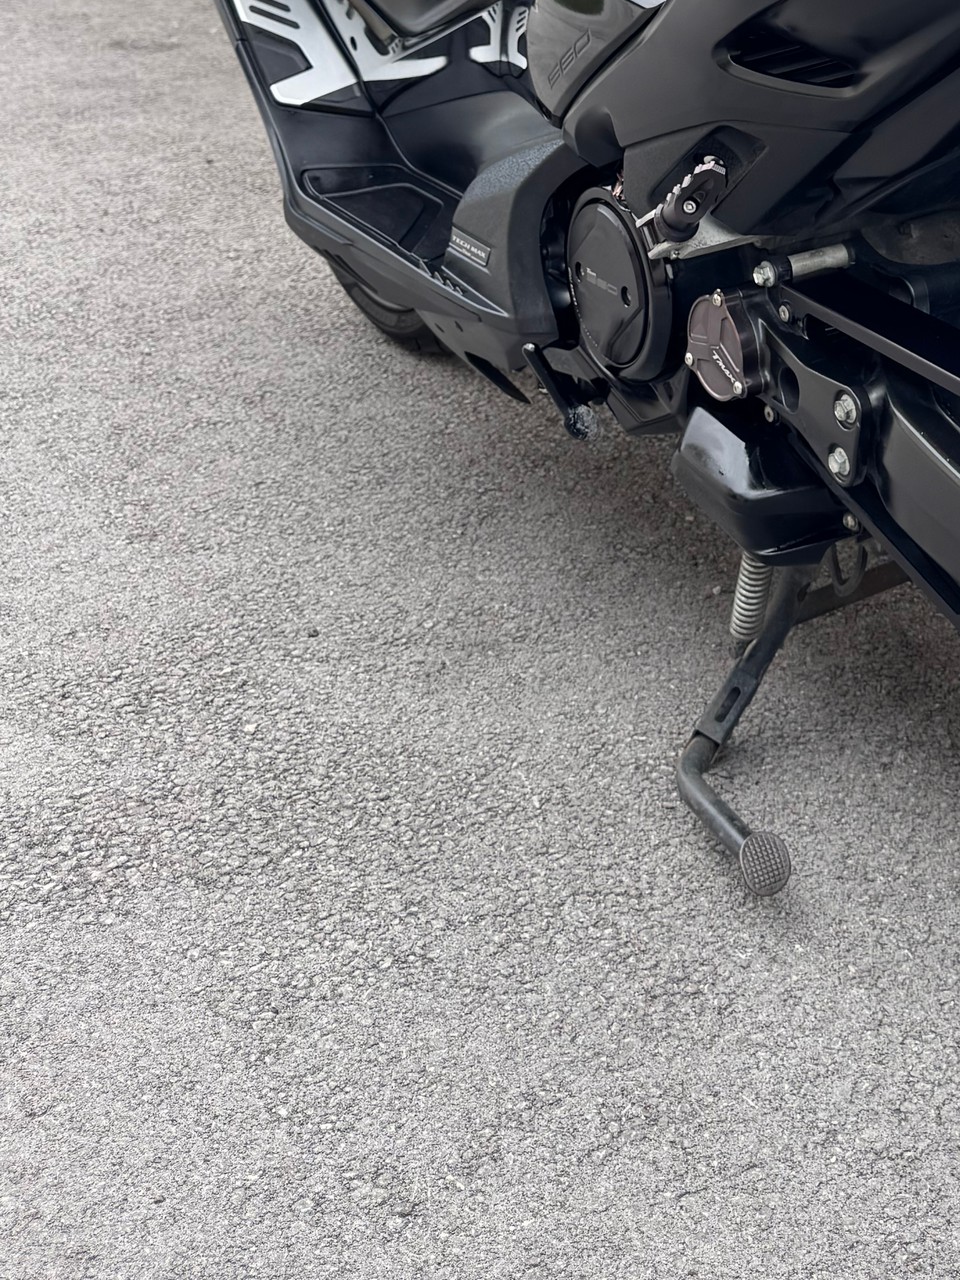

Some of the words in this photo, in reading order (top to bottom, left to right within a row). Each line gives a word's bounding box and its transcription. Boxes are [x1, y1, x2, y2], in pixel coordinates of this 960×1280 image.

[452, 235, 470, 250] TECH
[470, 246, 486, 259] MAX
[712, 350, 736, 383] TMAX
